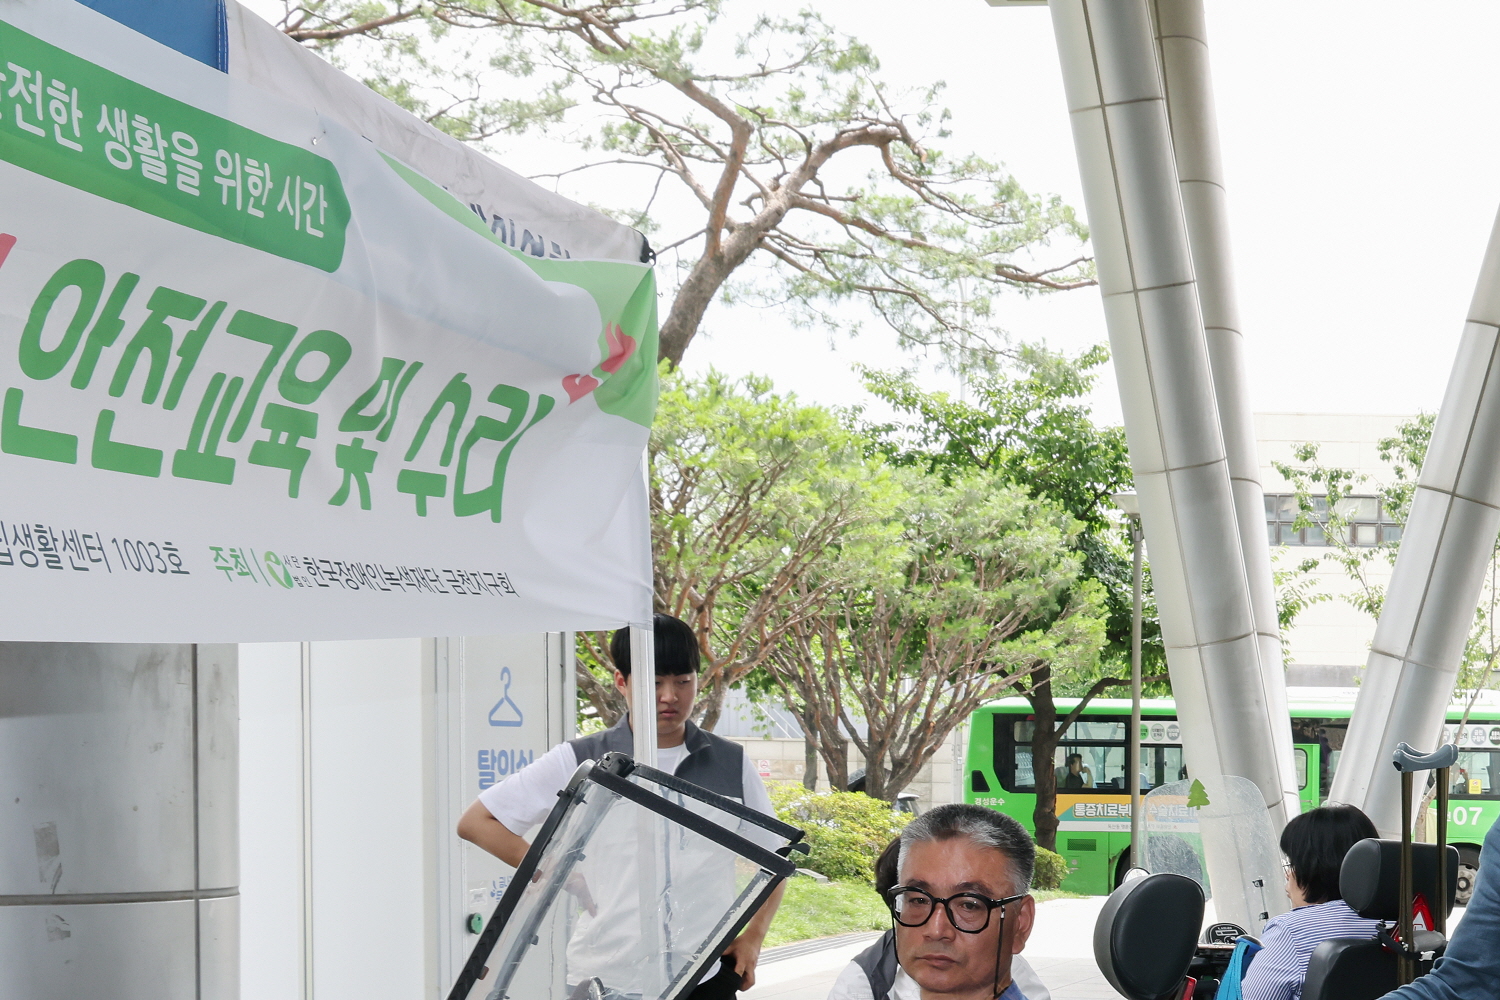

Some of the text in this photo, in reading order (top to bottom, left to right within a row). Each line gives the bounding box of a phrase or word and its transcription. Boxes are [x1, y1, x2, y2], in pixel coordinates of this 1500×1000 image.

[0, 62, 328, 238] 전한 생활을 위한 시간
[1, 258, 555, 523] 안전교육 및 수리
[111, 537, 190, 575] 1003호
[208, 545, 259, 583] 주최
[303, 556, 450, 594] 한국장애인녹색재단
